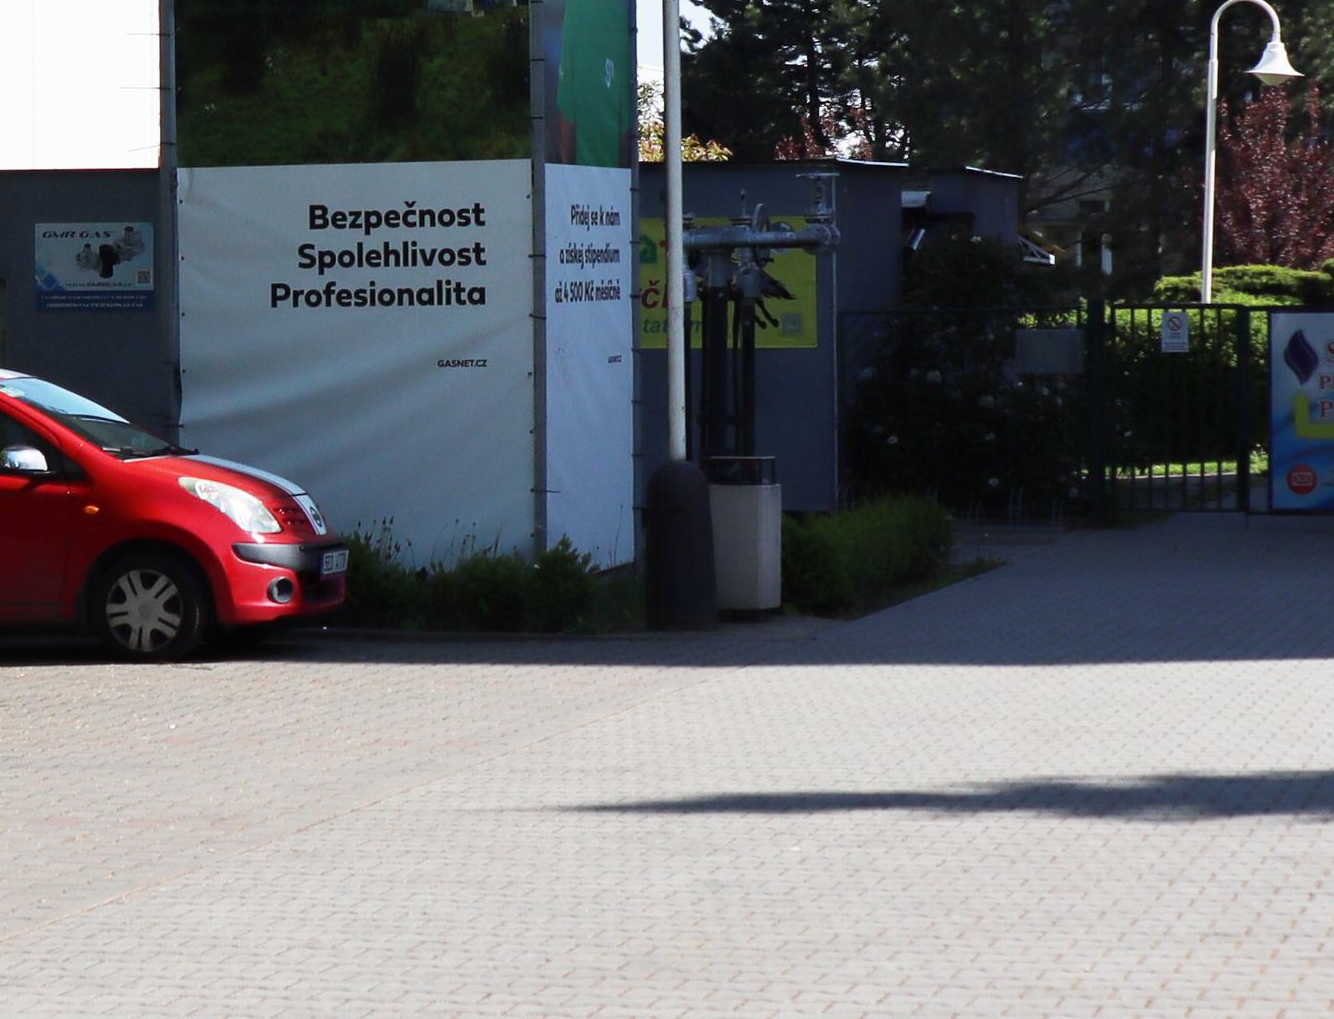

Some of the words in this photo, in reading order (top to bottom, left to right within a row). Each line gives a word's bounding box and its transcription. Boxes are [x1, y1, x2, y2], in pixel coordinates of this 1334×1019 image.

[308, 201, 486, 235] Bezpečnost
[297, 241, 487, 275] Spolehlivost
[270, 279, 486, 308] Profesionalita
[437, 359, 488, 368] GASNET.CZ
